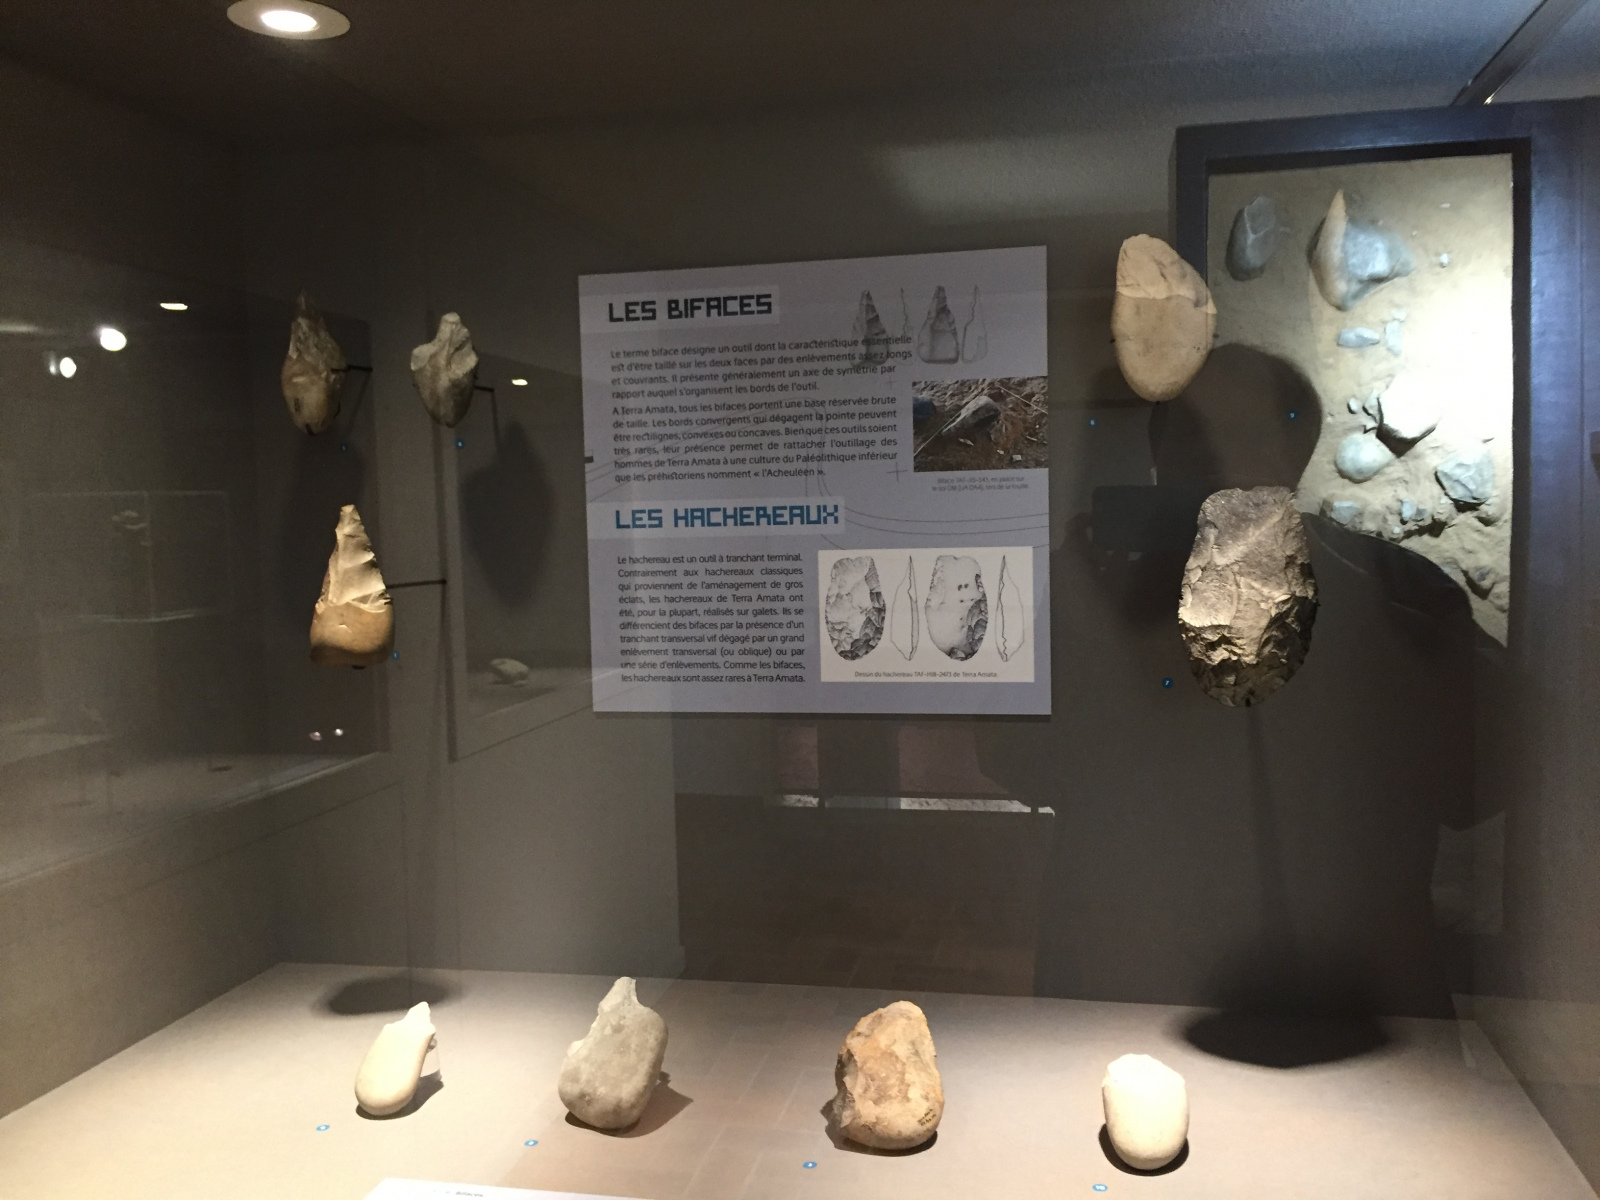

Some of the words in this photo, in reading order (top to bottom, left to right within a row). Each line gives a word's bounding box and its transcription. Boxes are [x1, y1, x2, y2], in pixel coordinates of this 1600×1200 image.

[608, 300, 657, 323] LES
[667, 293, 772, 320] BIFACES
[623, 374, 669, 385] couvrants.
[802, 369, 820, 377] axe
[881, 366, 896, 376] par
[612, 389, 645, 401] rapport
[647, 387, 677, 399] auquel
[679, 385, 733, 398] s'organisent
[735, 385, 747, 394] les
[750, 383, 776, 393] bords
[791, 382, 819, 392] l'outil.
[621, 405, 643, 415] Terra
[644, 404, 677, 415] Amata,
[678, 403, 699, 413] tous
[700, 403, 712, 412] les
[714, 401, 747, 411] bifaces
[749, 400, 783, 412] portent
[785, 401, 802, 409] une
[804, 398, 826, 408] base
[871, 396, 897, 405] brute
[626, 418, 649, 428] taille.
[652, 418, 667, 427] Les
[668, 417, 694, 426] bords
[695, 415, 751, 427] convergents
[753, 414, 767, 425] qui
[826, 411, 856, 422] pointe
[858, 409, 897, 421] peuvent
[632, 431, 681, 443] rectilignes,
[682, 431, 724, 440] convexes
[738, 429, 783, 438] concaves.
[785, 427, 804, 436] Bien
[805, 428, 823, 437] que
[825, 427, 840, 435] ces
[841, 425, 867, 434] outils
[868, 424, 897, 433] soient
[634, 446, 659, 456] rares,
[663, 444, 680, 454] leur
[730, 441, 763, 453] permet
[783, 439, 826, 449] rattacher
[830, 438, 876, 450] l'outillage
[881, 437, 898, 446] des
[614, 458, 652, 468] hommes
[667, 457, 689, 467] Terra
[691, 456, 721, 466] Amata
[730, 457, 747, 465] une
[749, 455, 781, 464] culture
[615, 474, 631, 483] que
[633, 472, 646, 481] les
[707, 469, 751, 479] nomment
[615, 509, 663, 529] LES
[673, 504, 839, 528] HACHEREAUX
[629, 555, 671, 564] hachereau
[672, 554, 685, 564] est
[699, 554, 717, 563] outil
[726, 553, 765, 563] tranchant
[767, 553, 802, 562] terminal.
[618, 568, 677, 578] Contrairement
[683, 569, 699, 577] aux
[705, 566, 754, 576] hachereaux
[760, 566, 803, 577] classiques
[618, 581, 631, 592] qui
[634, 581, 683, 592] proviennent
[785, 582, 804, 591] gros
[637, 609, 656, 619] pour
[669, 607, 701, 618] plupart,
[752, 606, 779, 618] galets.
[783, 606, 792, 615] Ils
[672, 620, 687, 629] des
[689, 620, 718, 629] bifaces
[720, 622, 733, 631] par
[786, 620, 804, 629] d'un
[620, 633, 659, 643] tranchant
[661, 633, 705, 643] transversal
[707, 633, 717, 643] vif
[752, 635, 765, 644] par
[780, 633, 805, 644] grand
[672, 646, 717, 656] transversal
[720, 646, 734, 657] (ou
[738, 646, 772, 657] oblique)
[790, 648, 805, 657] par
[723, 660, 757, 669] Comme
[759, 660, 771, 669] les
[773, 660, 805, 670] bifaces,
[621, 673, 633, 682] les
[634, 673, 681, 682] hachereaux
[682, 673, 700, 682] sont
[753, 673, 774, 682] Terra
[775, 673, 806, 682] Amata.
